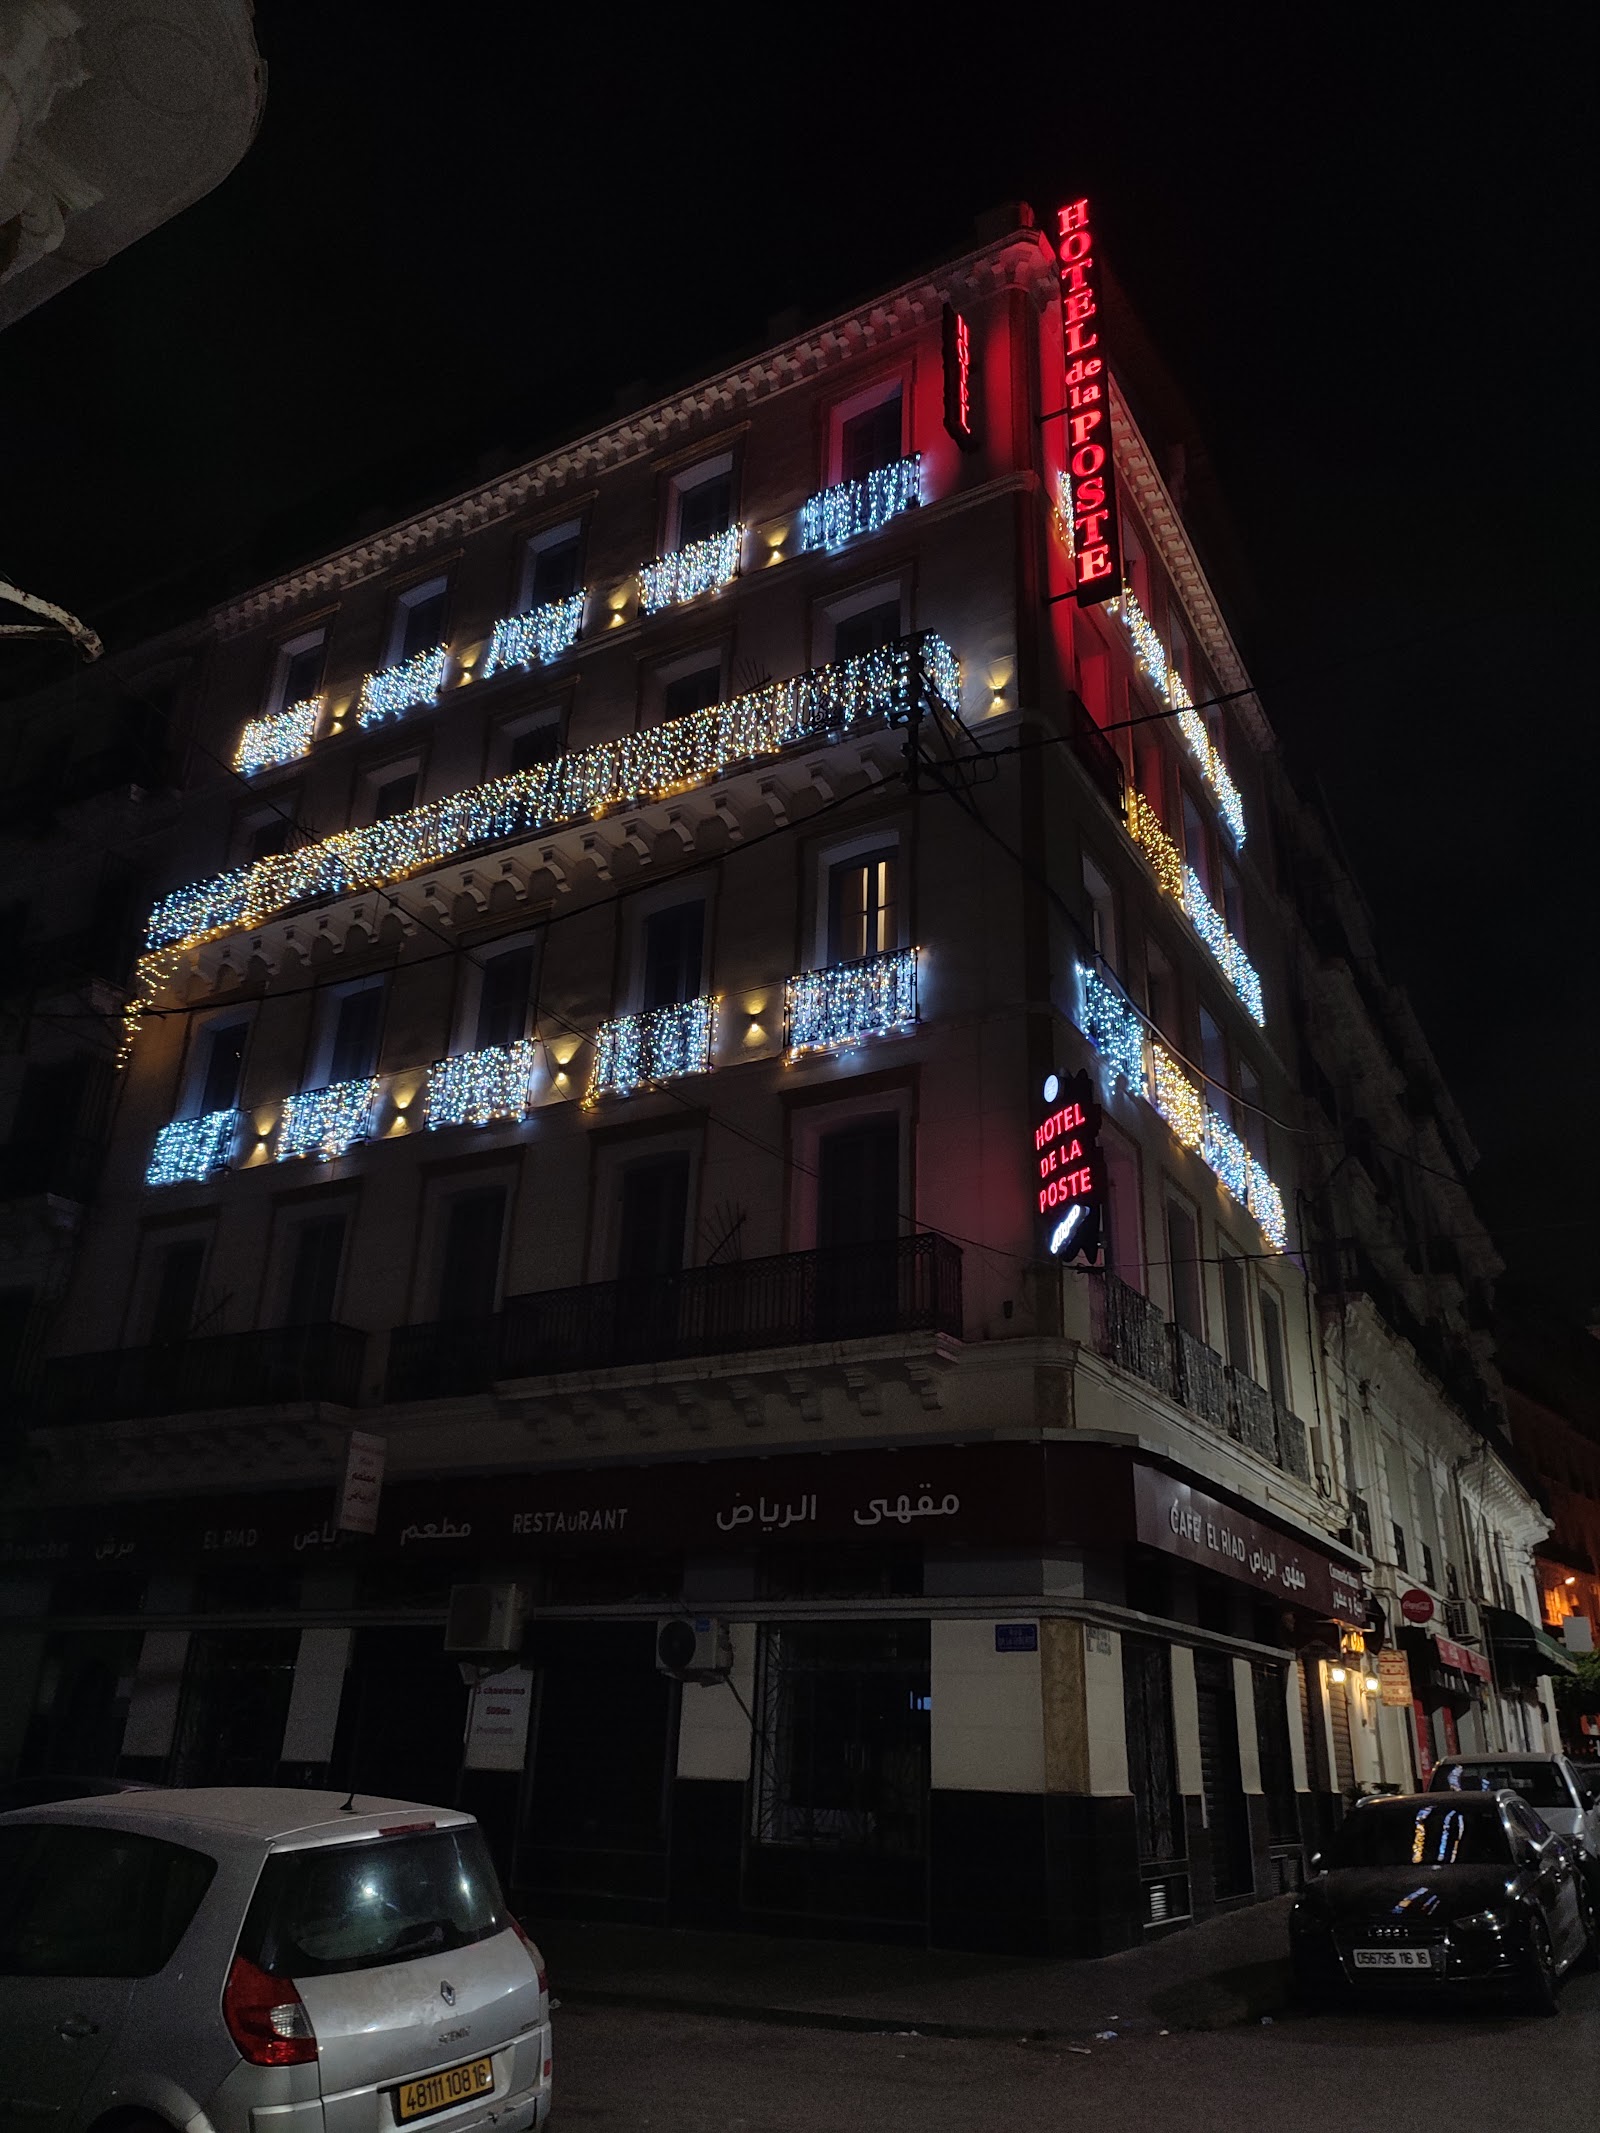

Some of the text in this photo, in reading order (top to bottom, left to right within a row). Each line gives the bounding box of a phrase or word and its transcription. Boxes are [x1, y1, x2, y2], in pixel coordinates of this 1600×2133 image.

[1058, 199, 1112, 583] HOTEL de la POSTE
[1035, 1103, 1086, 1150] HOTEL
[1040, 1139, 1083, 1178] DE LA
[1039, 1167, 1092, 1213] POSTE
[716, 1482, 960, 1532] مقهى الرياض
[400, 1517, 472, 1547] مطعم
[1206, 1522, 1220, 1551] EL
[406, 2063, 487, 2111] 48111 108 16
